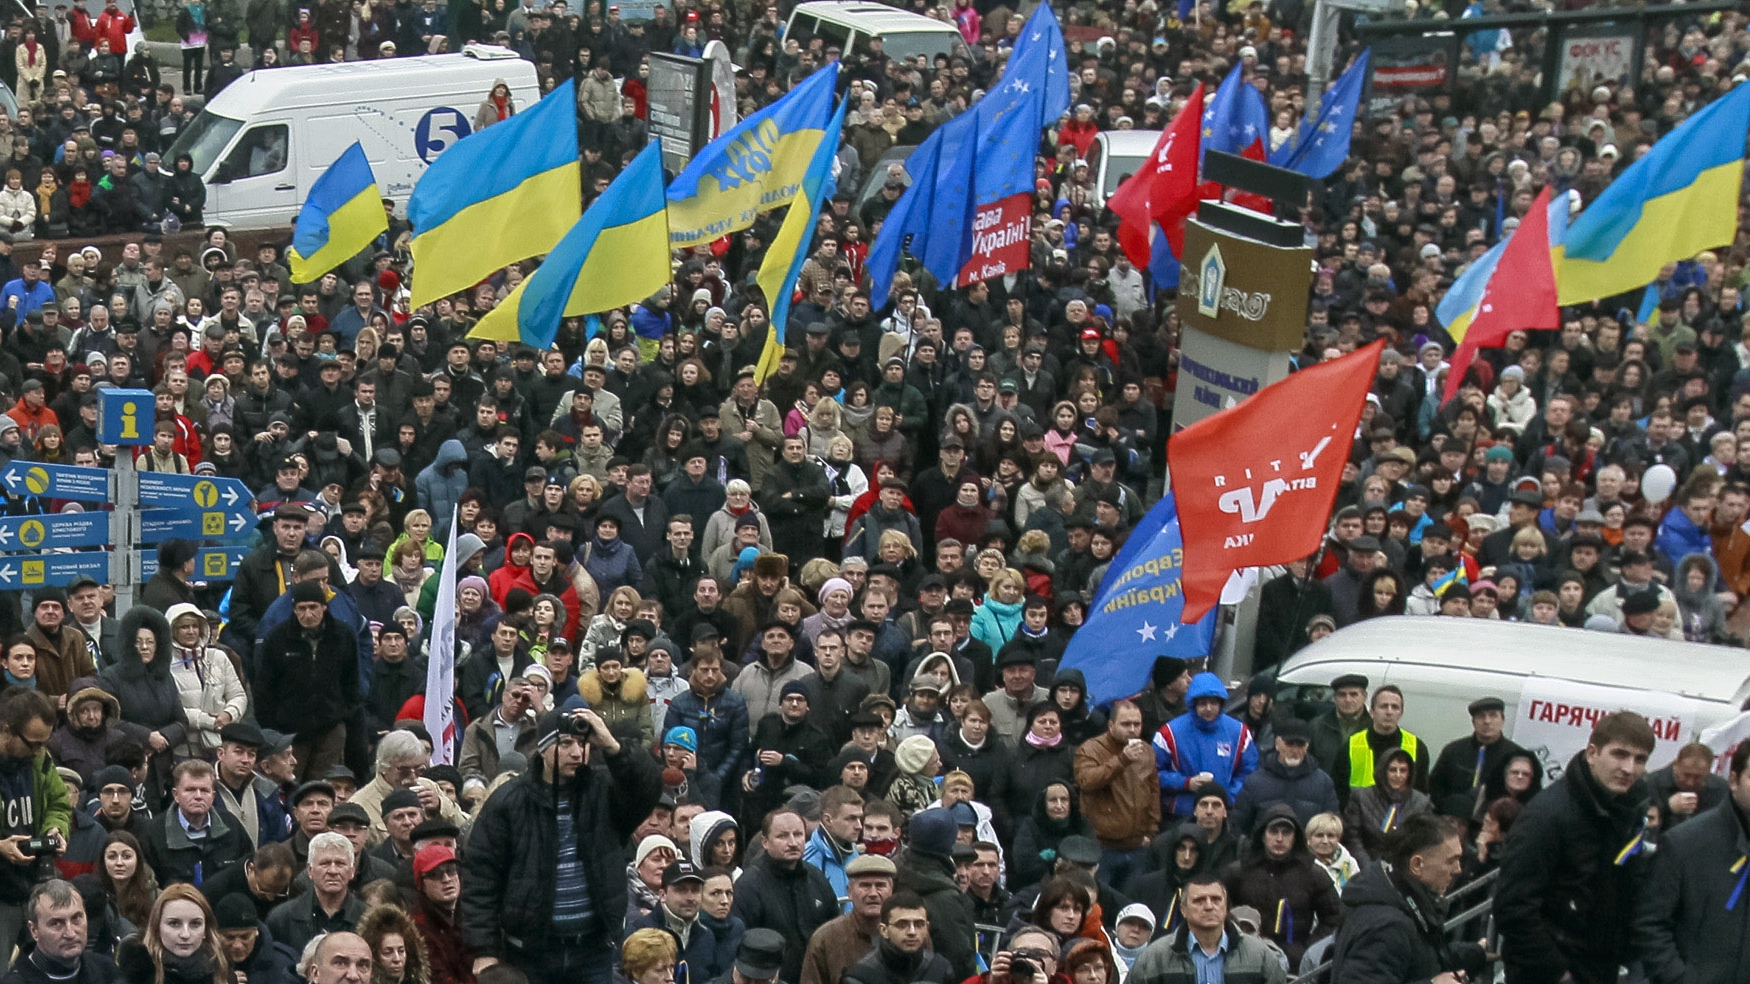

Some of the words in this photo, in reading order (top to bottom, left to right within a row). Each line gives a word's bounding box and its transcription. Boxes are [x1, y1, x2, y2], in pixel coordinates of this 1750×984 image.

[426, 112, 460, 162] 5
[972, 207, 1003, 231] ава
[1529, 700, 1607, 729] ГАРЯЧ
[1647, 717, 1681, 741] АЙ
